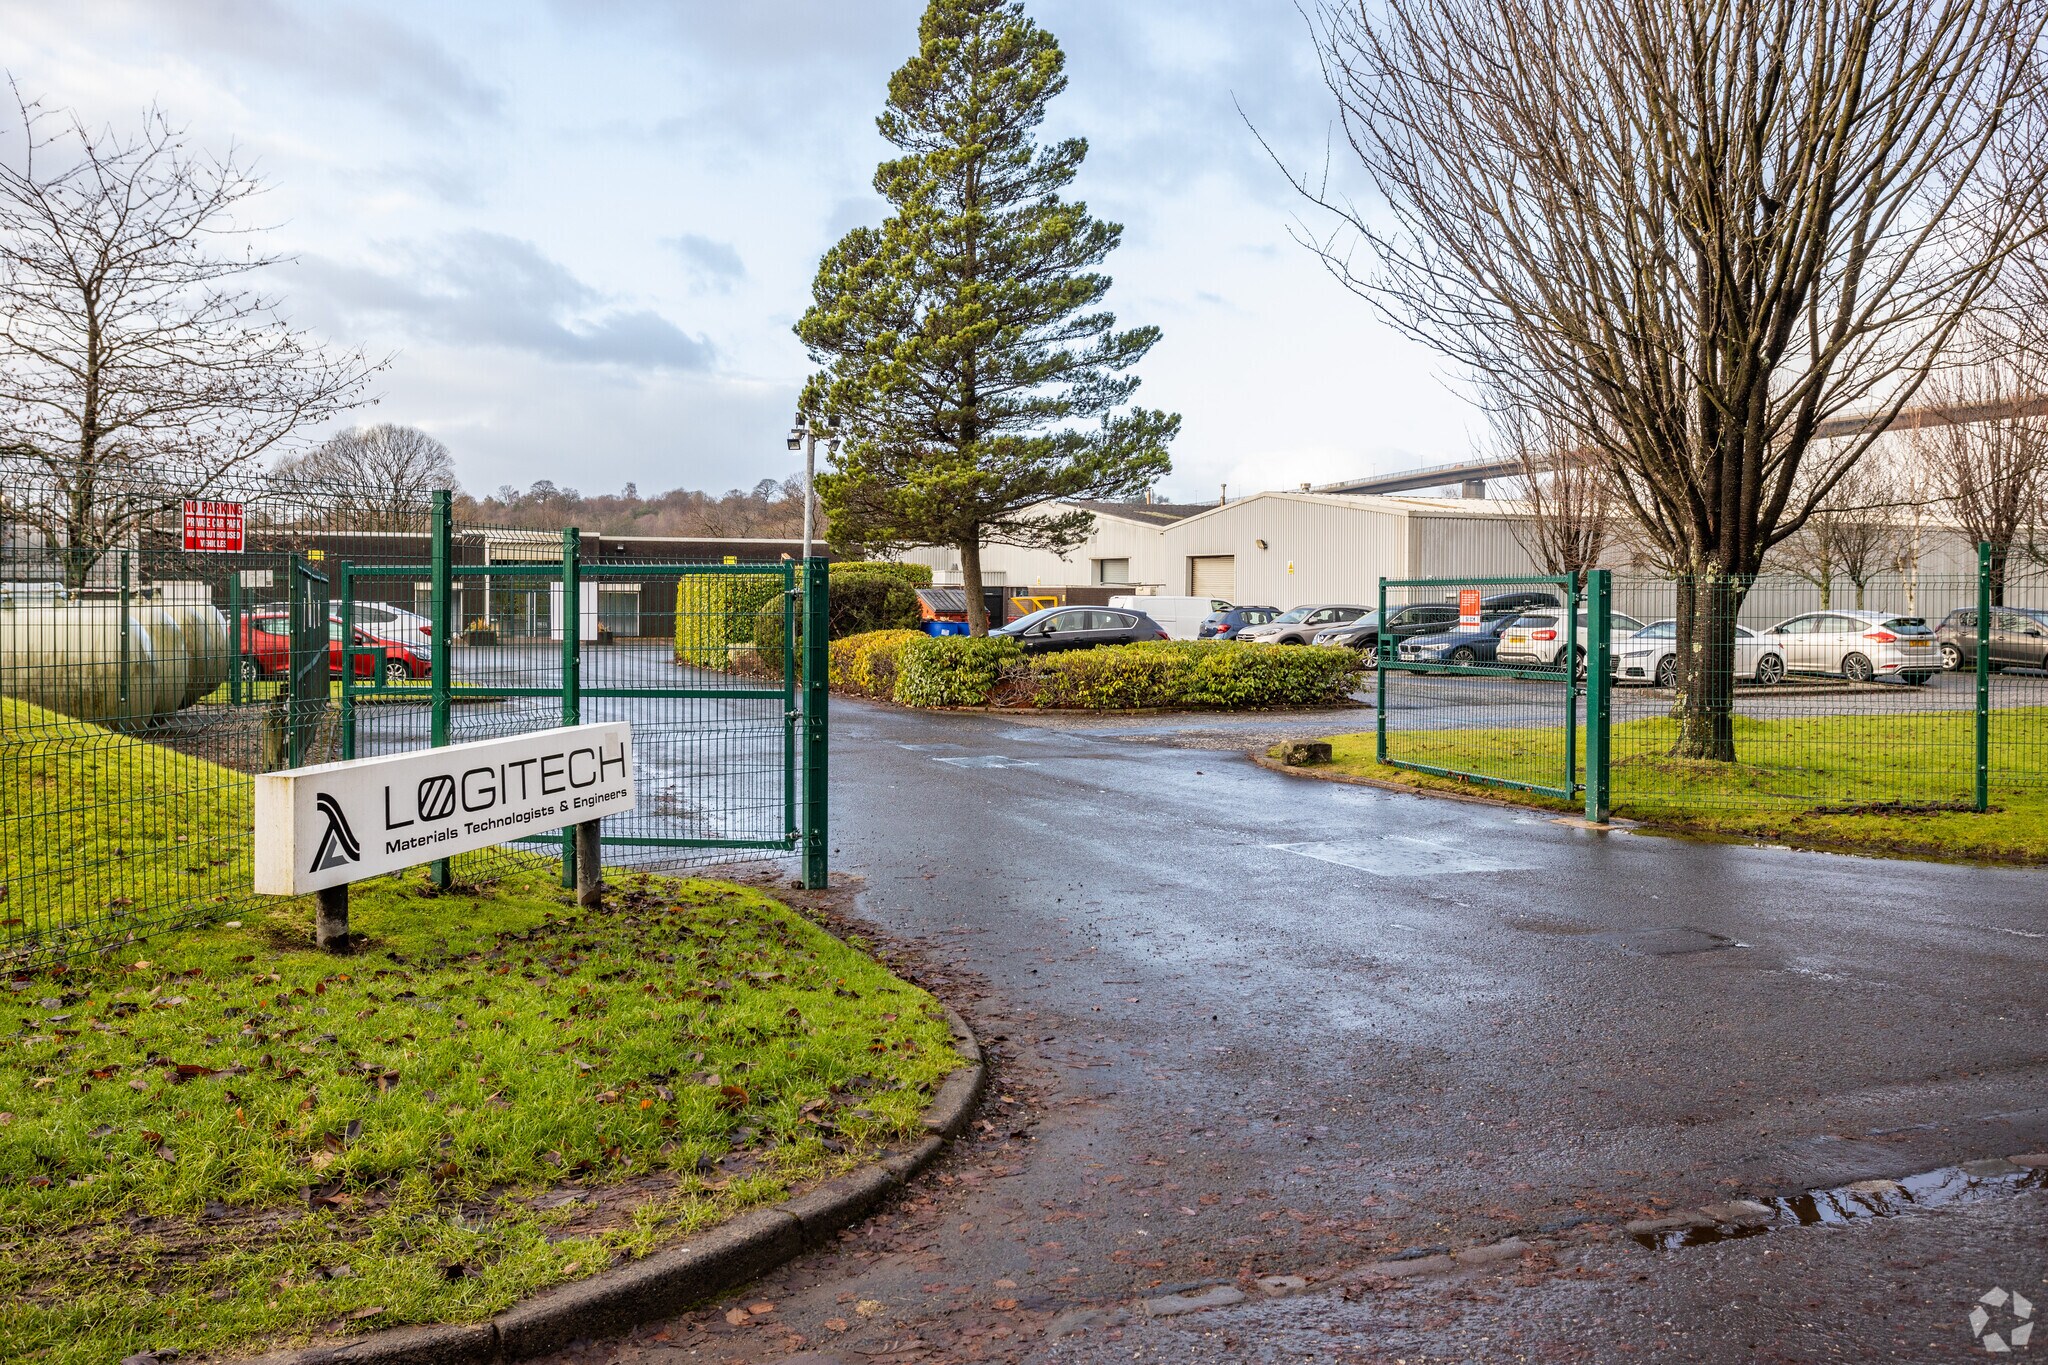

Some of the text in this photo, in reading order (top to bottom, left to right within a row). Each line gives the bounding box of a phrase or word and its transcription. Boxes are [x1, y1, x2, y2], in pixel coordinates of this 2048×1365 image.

[184, 501, 243, 515] NO PARKING
[211, 518, 225, 528] CAR
[226, 518, 241, 529] PARK
[186, 530, 196, 538] NO
[200, 540, 227, 548] VEHICLES
[385, 742, 626, 831] LOGITECH
[386, 788, 628, 855] Materials Technologists & Engineers
